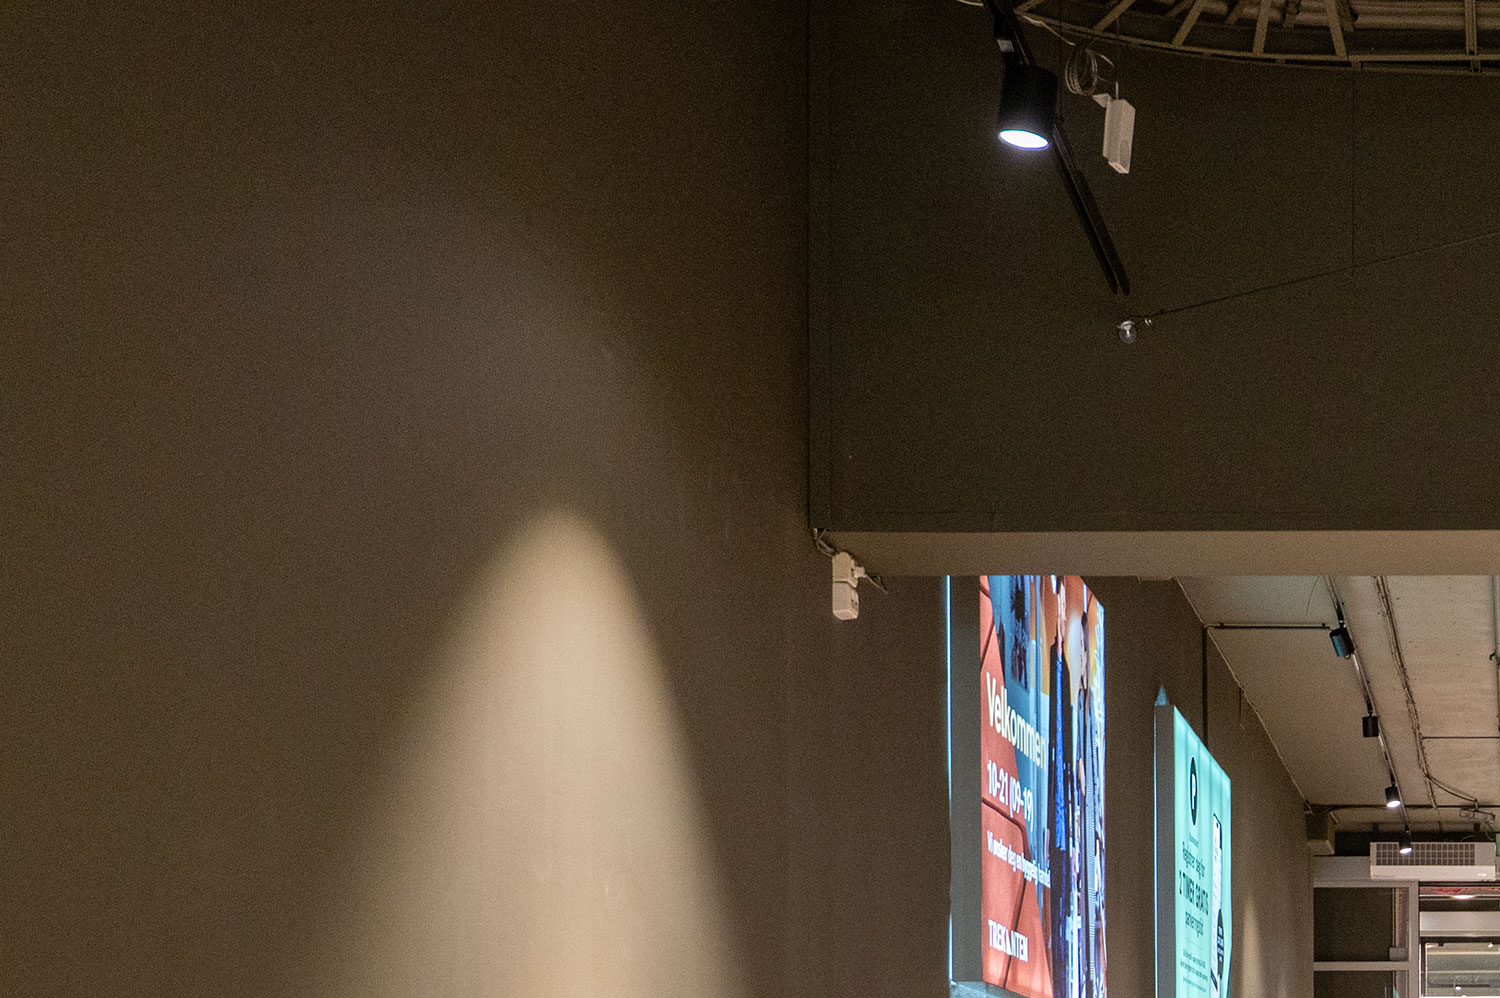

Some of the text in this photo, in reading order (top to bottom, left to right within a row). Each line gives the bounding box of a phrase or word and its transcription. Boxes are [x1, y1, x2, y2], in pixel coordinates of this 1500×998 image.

[986, 671, 1047, 772] Velkommen
[987, 759, 1033, 832] 10-21 (09-19)
[988, 918, 1029, 963] TREKANTEN
